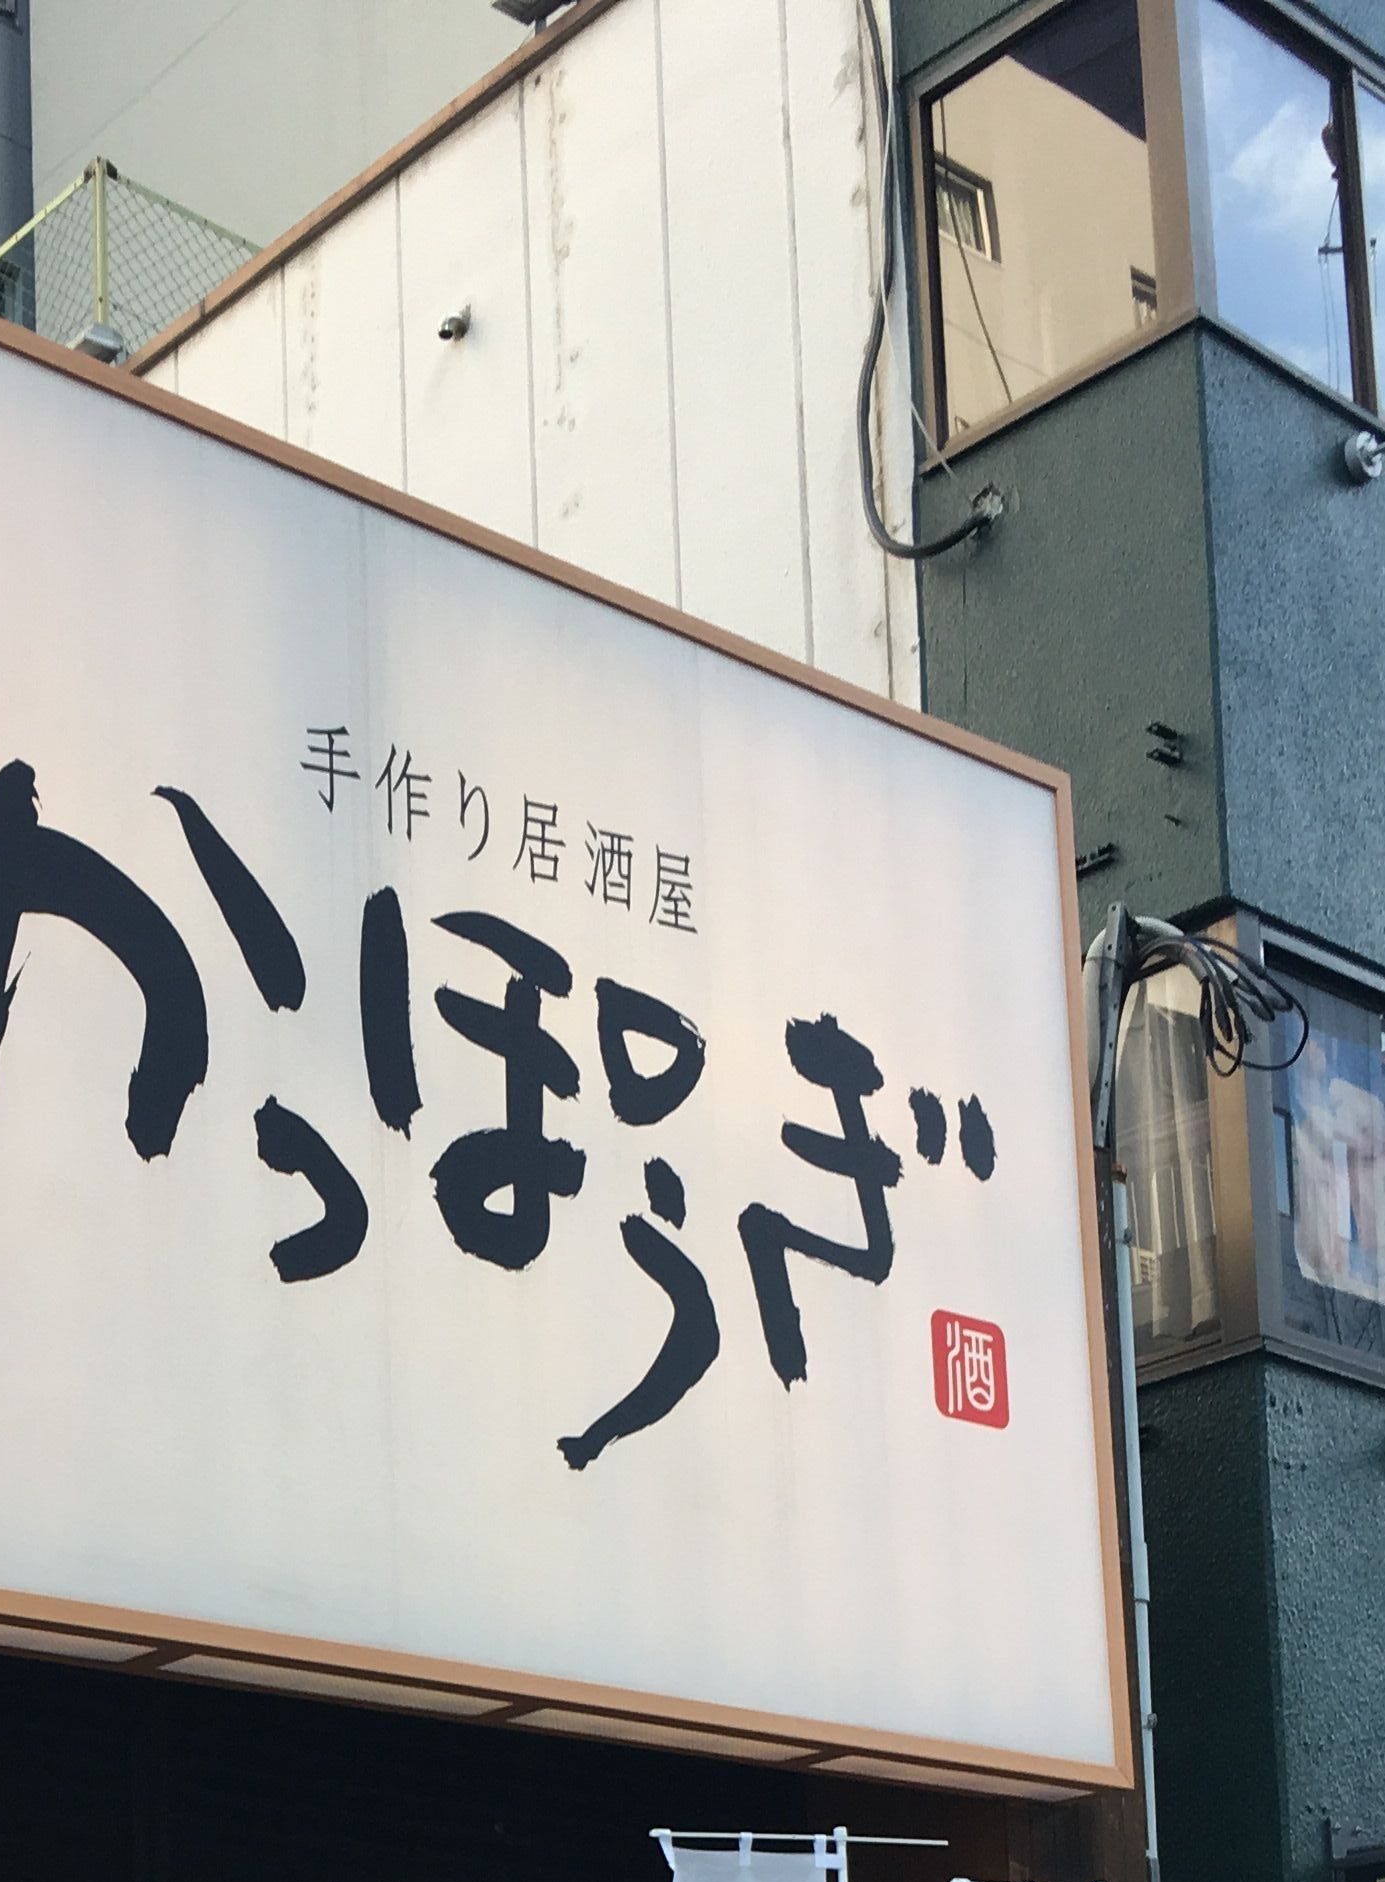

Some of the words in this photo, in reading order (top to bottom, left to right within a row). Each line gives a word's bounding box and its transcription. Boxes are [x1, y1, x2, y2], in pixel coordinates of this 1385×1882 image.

[300, 725, 698, 935] 手作り居酒屋
[941, 1320, 1002, 1421] 酒
